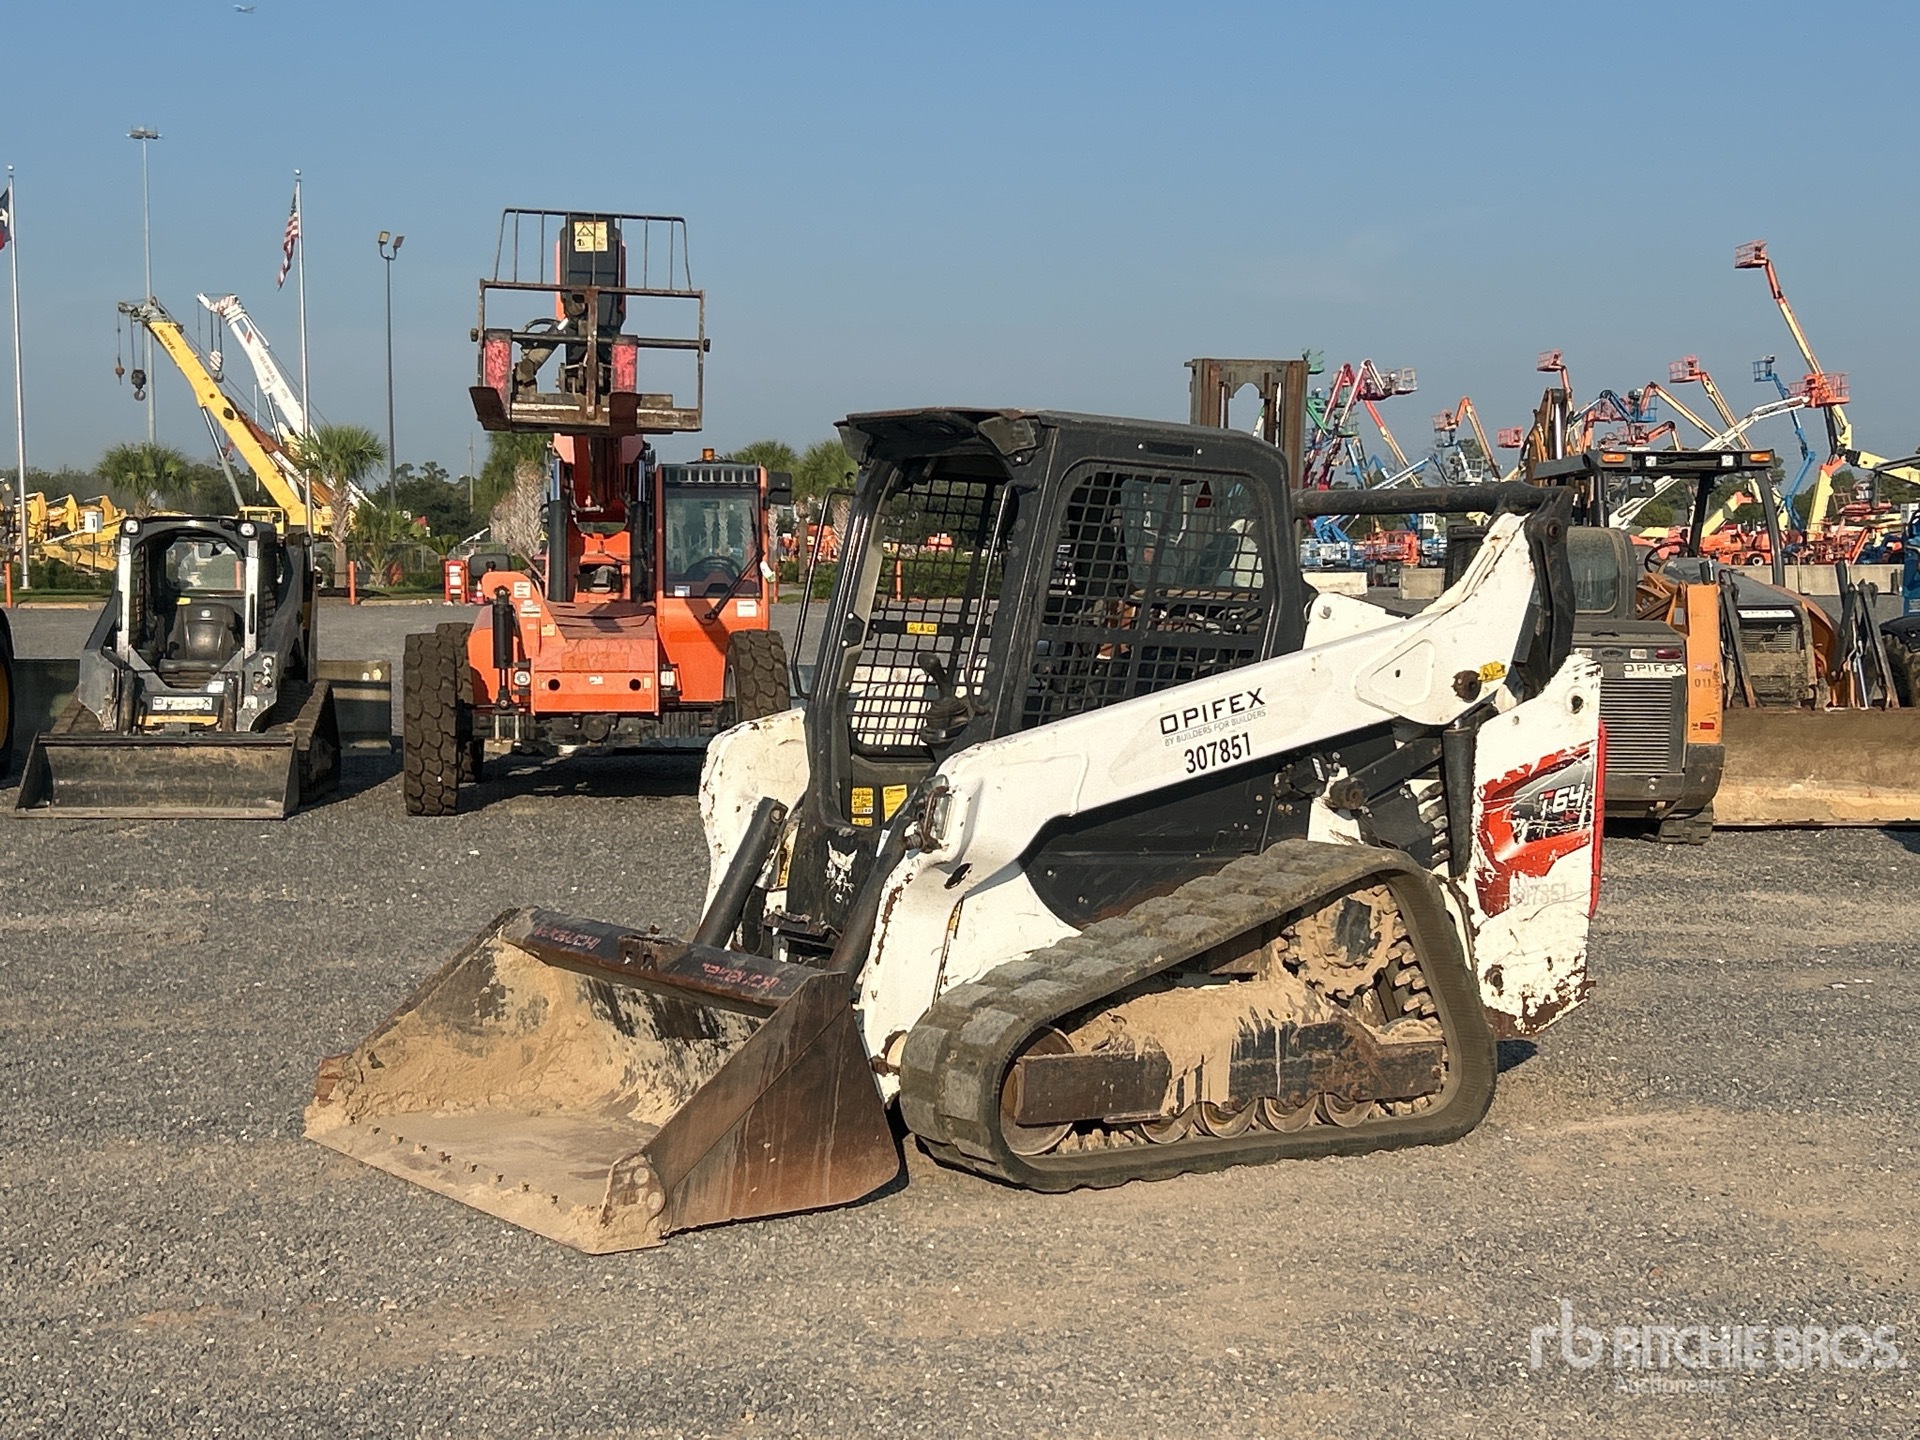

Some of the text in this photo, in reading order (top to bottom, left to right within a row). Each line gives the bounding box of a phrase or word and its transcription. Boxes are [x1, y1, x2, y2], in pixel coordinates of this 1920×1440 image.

[1623, 663, 1686, 673] OPIFEX
[1159, 686, 1266, 736] OPIFEX
[1164, 708, 1267, 747] BY BUILDERS FOR BUILDERS
[1183, 731, 1251, 774] 307851
